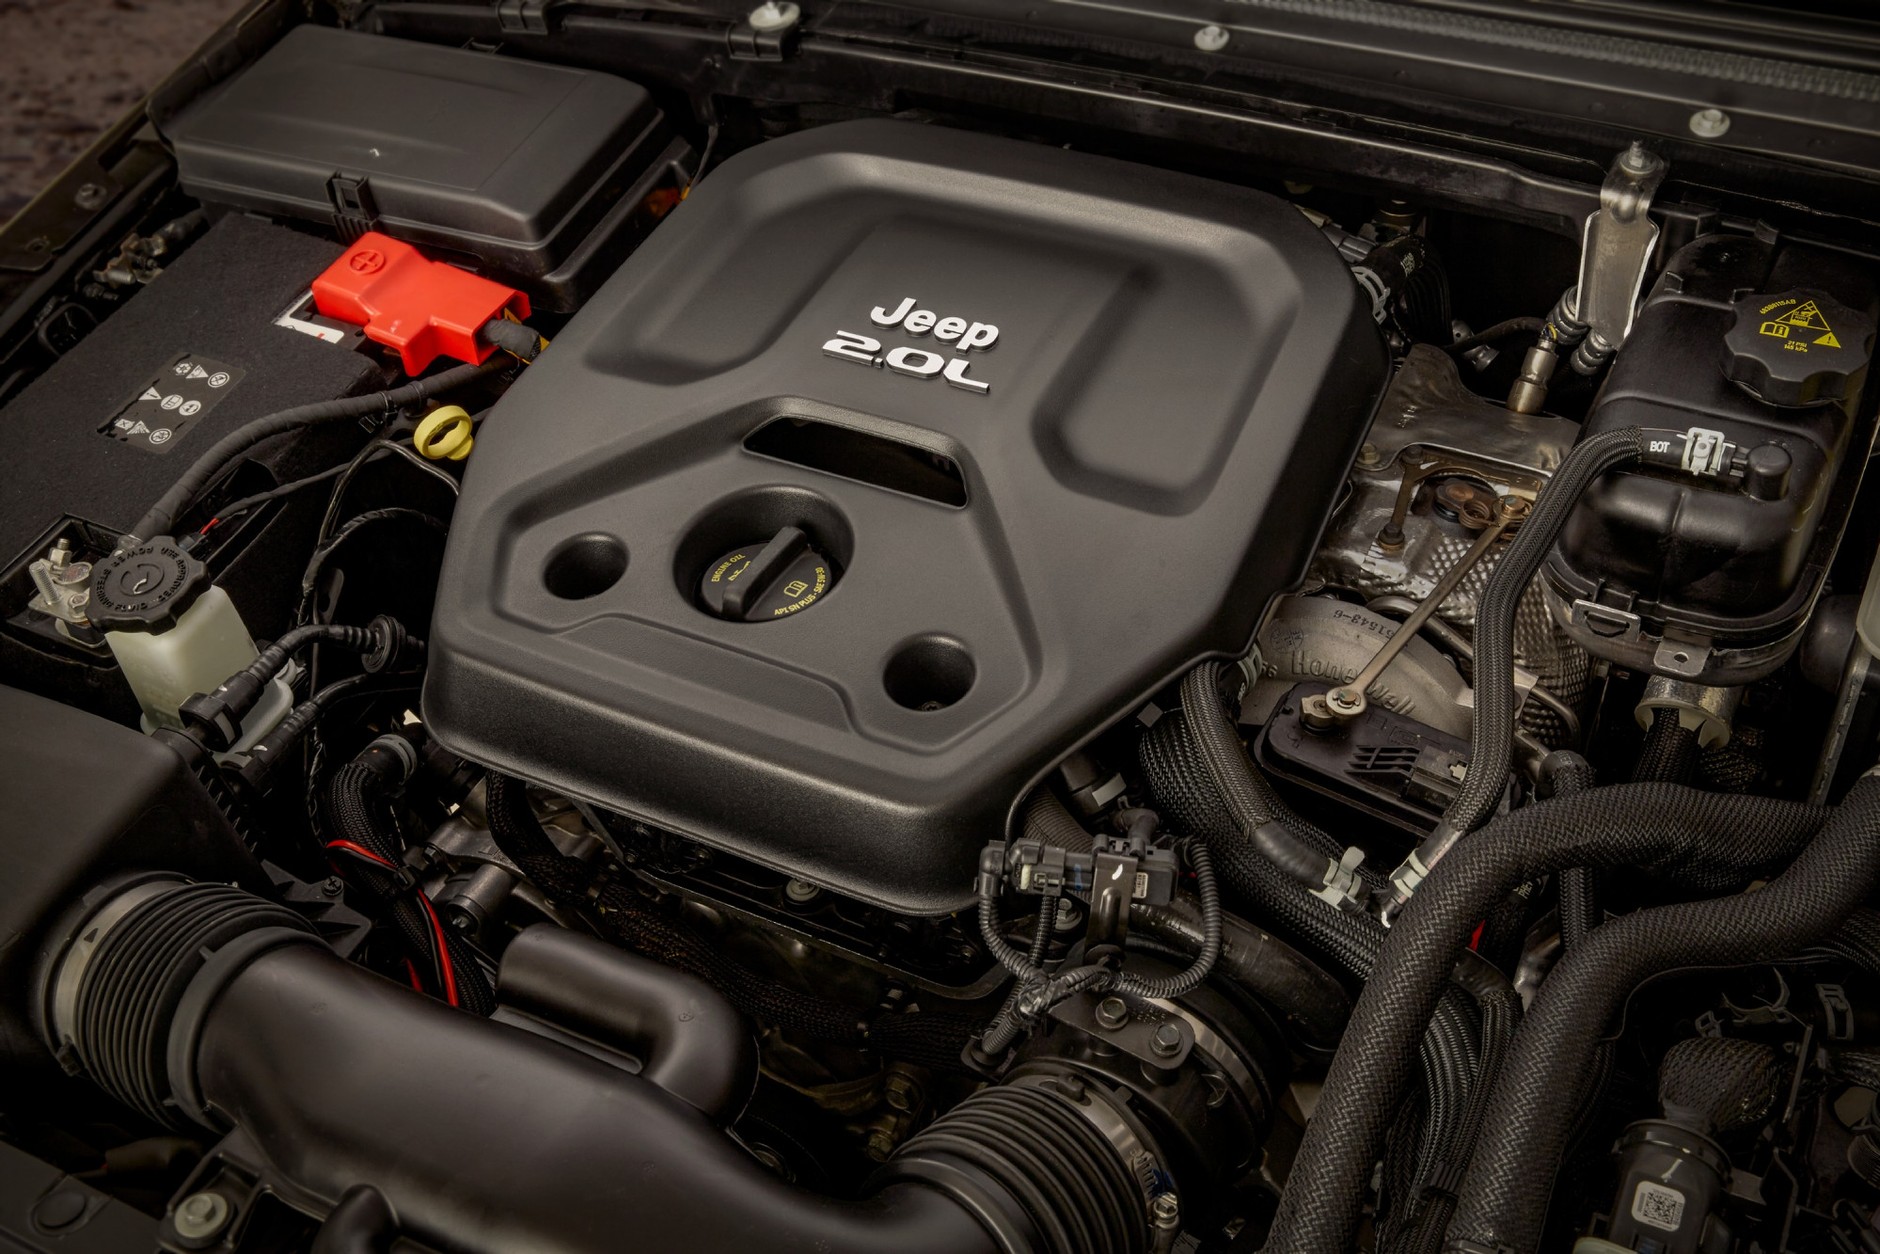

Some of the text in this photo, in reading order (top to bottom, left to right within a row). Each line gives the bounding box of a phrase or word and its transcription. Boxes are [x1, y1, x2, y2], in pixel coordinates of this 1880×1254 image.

[870, 297, 999, 355] Jeep
[822, 330, 990, 394] 2.0L
[1650, 441, 1670, 453] BOT
[111, 546, 154, 568] POWER
[711, 553, 745, 582] ENGINE OIL
[774, 608, 789, 616] API
[798, 594, 816, 607] PLUS
[1291, 650, 1416, 715] Honewell
